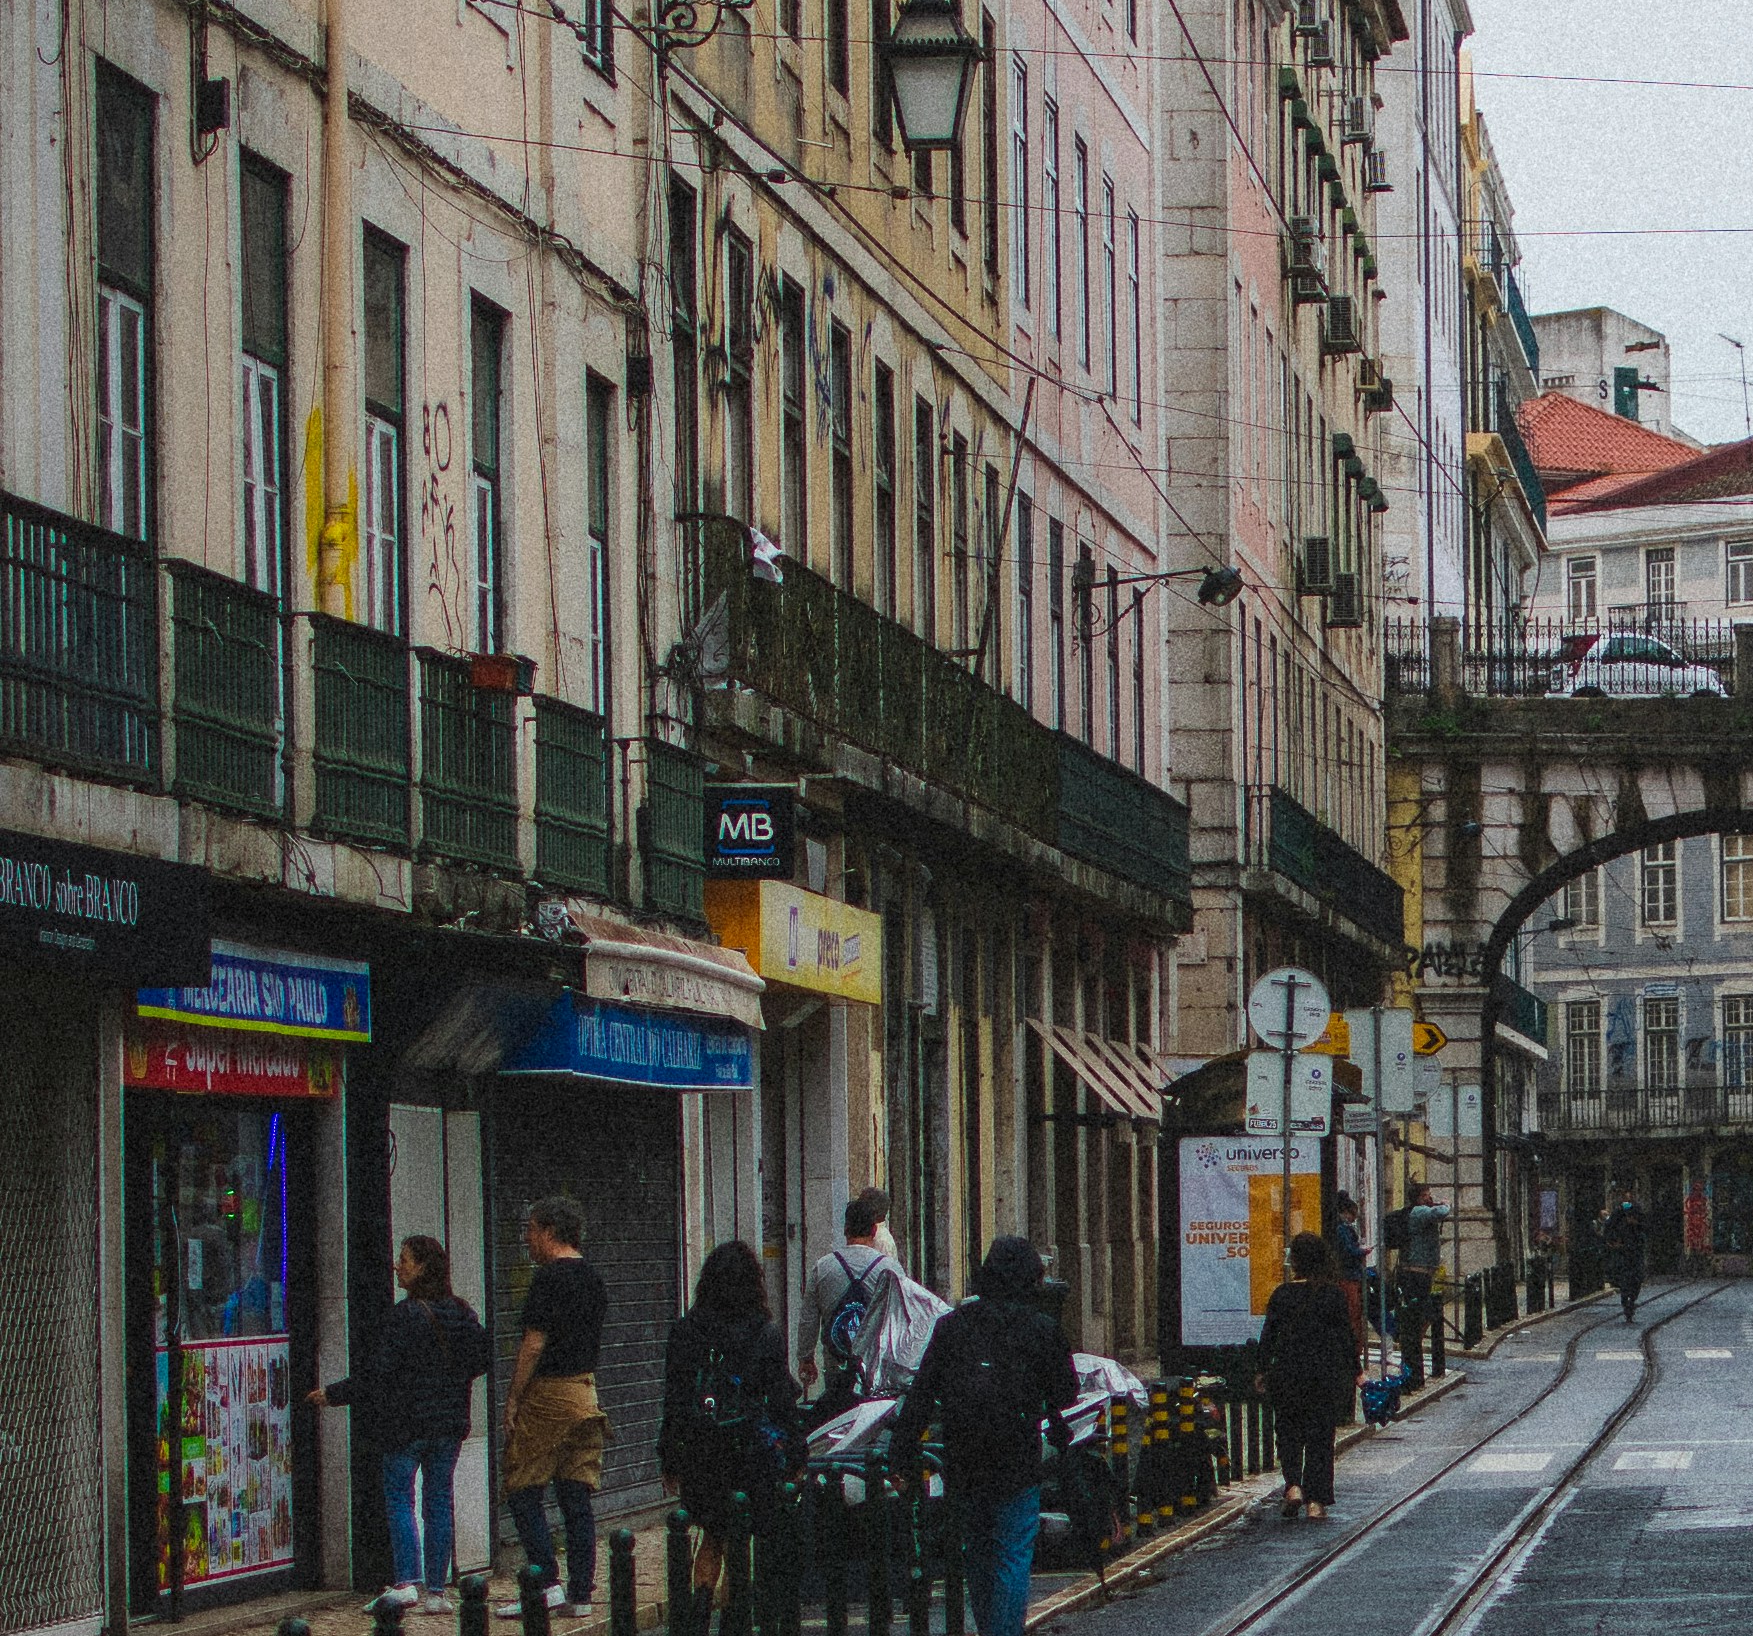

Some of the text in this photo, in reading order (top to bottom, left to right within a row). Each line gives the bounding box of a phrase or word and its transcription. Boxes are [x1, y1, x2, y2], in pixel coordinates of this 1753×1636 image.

[717, 811, 775, 842] MB
[711, 856, 782, 868] MULTIBANCO
[55, 867, 84, 918] sobre
[84, 873, 140, 927] BRANCO
[287, 975, 330, 1025] PAULO
[1225, 1144, 1300, 1162] universo
[1189, 1220, 1250, 1232] SEGUROS
[1185, 1232, 1250, 1245] UNIVER
